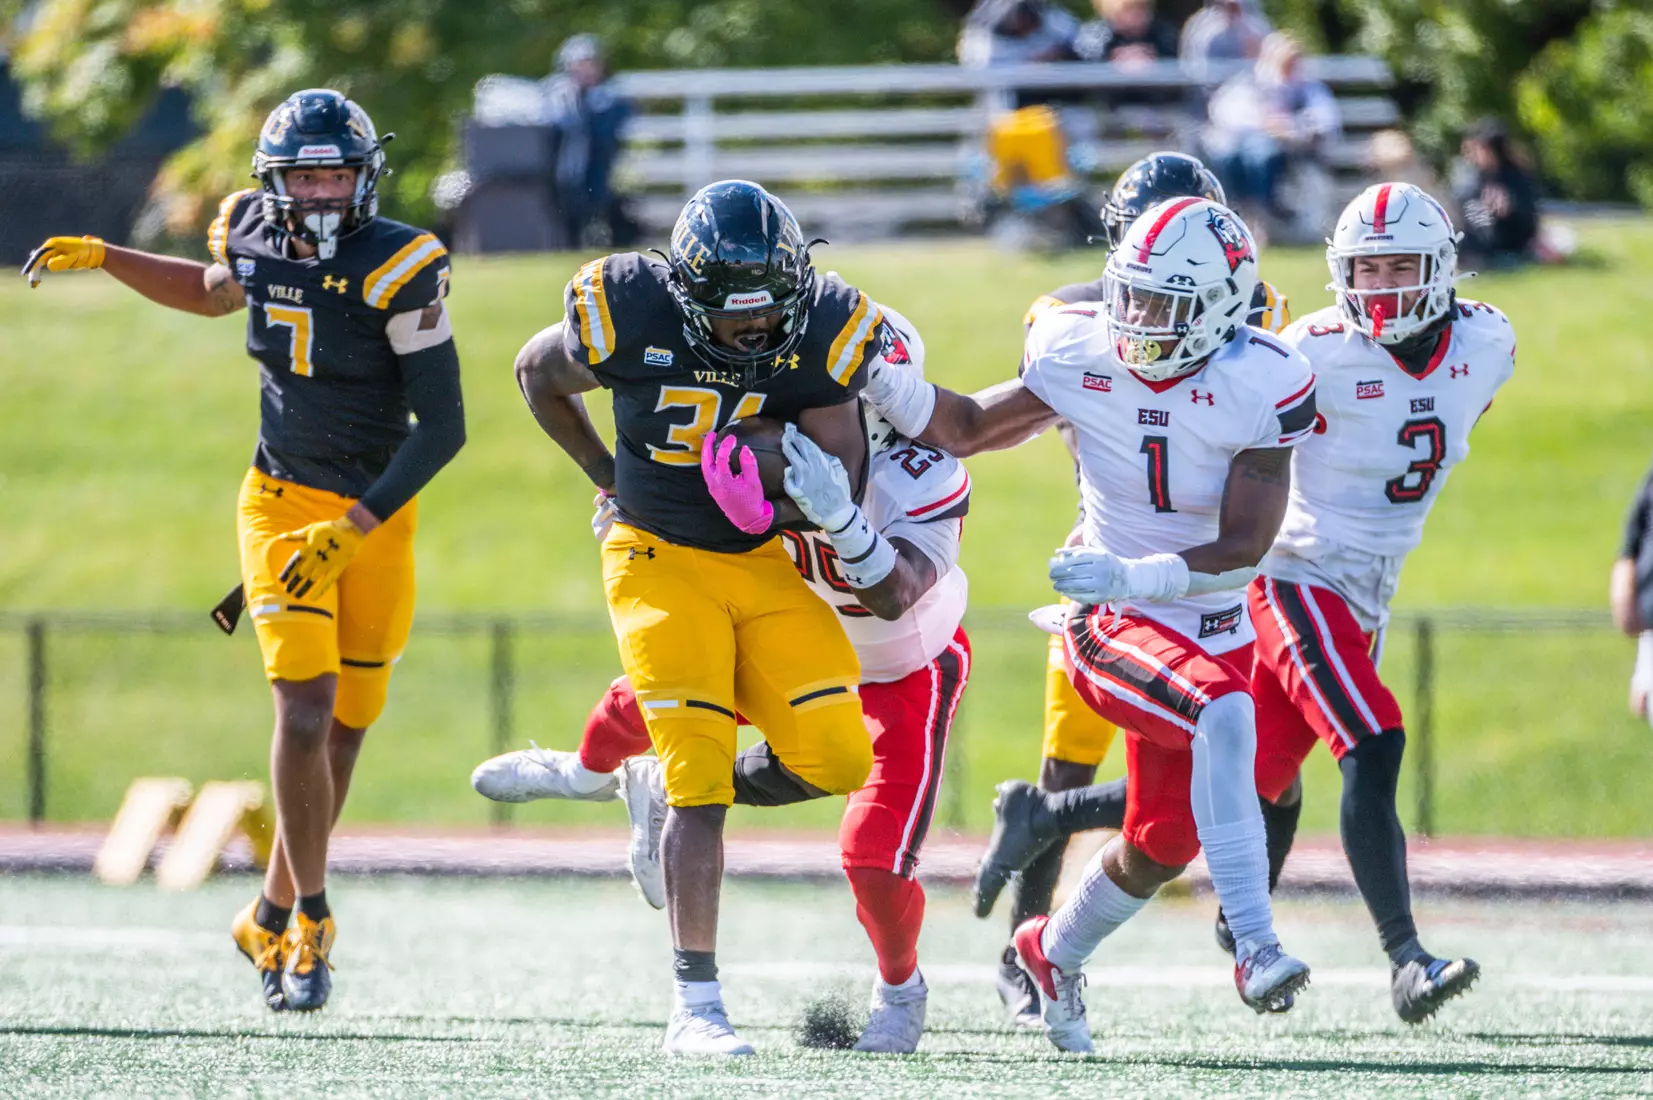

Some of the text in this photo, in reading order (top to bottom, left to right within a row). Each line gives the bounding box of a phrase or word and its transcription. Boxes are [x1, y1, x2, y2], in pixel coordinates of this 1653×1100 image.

[268, 283, 304, 304] VILLE
[731, 296, 767, 305] Riddell
[263, 302, 314, 377] 7
[1249, 336, 1289, 358] 1
[646, 352, 671, 362] PSAC
[1083, 376, 1112, 389] PSAC
[1356, 384, 1384, 396] PSAC
[1409, 396, 1435, 413] ESU
[1138, 408, 1170, 427] ESU
[1384, 416, 1446, 504] 3
[1139, 435, 1178, 513] 1
